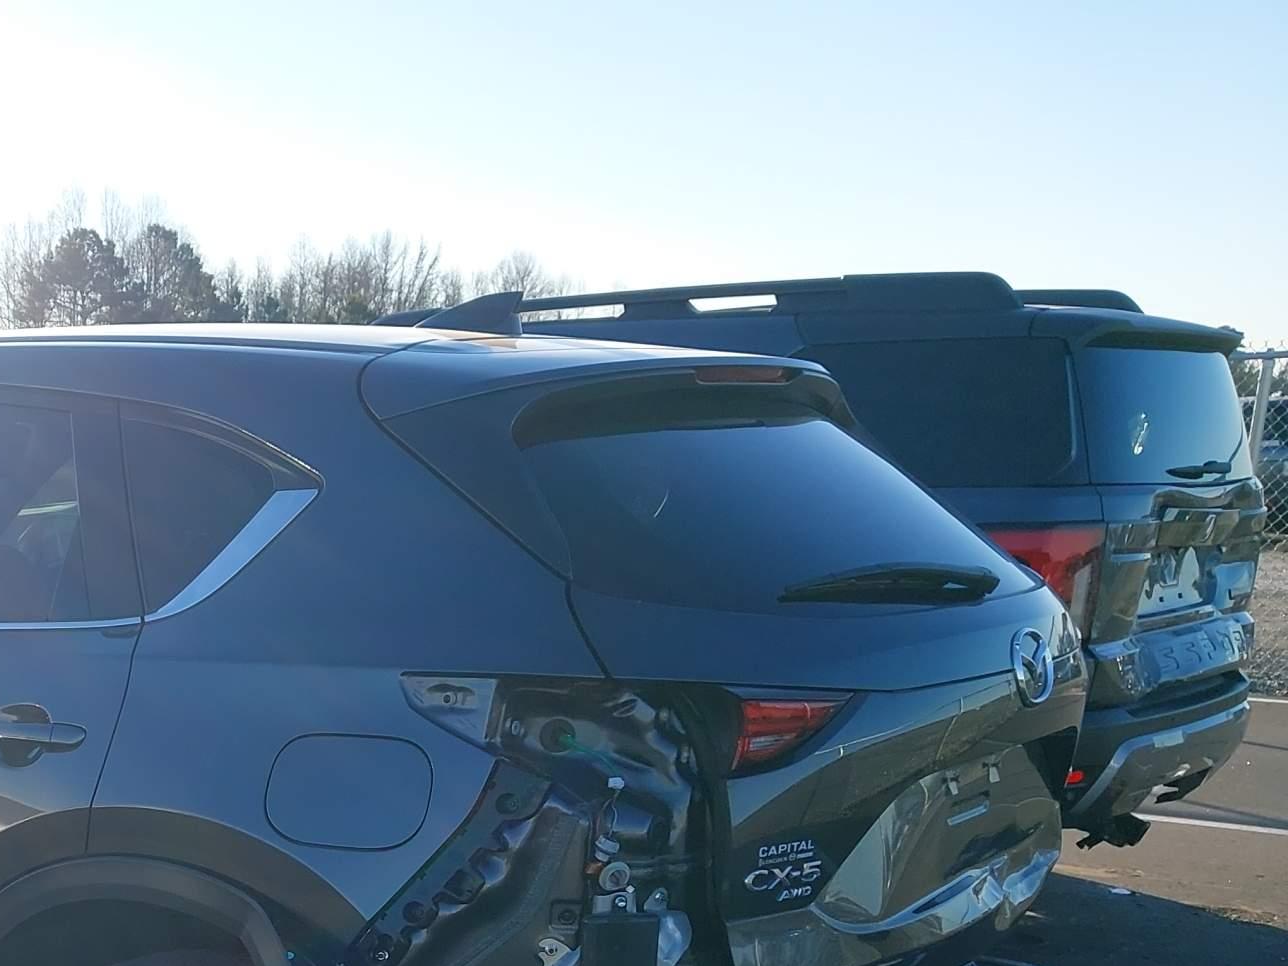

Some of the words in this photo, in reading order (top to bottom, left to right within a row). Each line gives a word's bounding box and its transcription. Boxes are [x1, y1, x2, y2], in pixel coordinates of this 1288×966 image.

[758, 839, 814, 857] CAPITAL
[744, 860, 822, 891] CX-5
[778, 886, 812, 901] AWD
